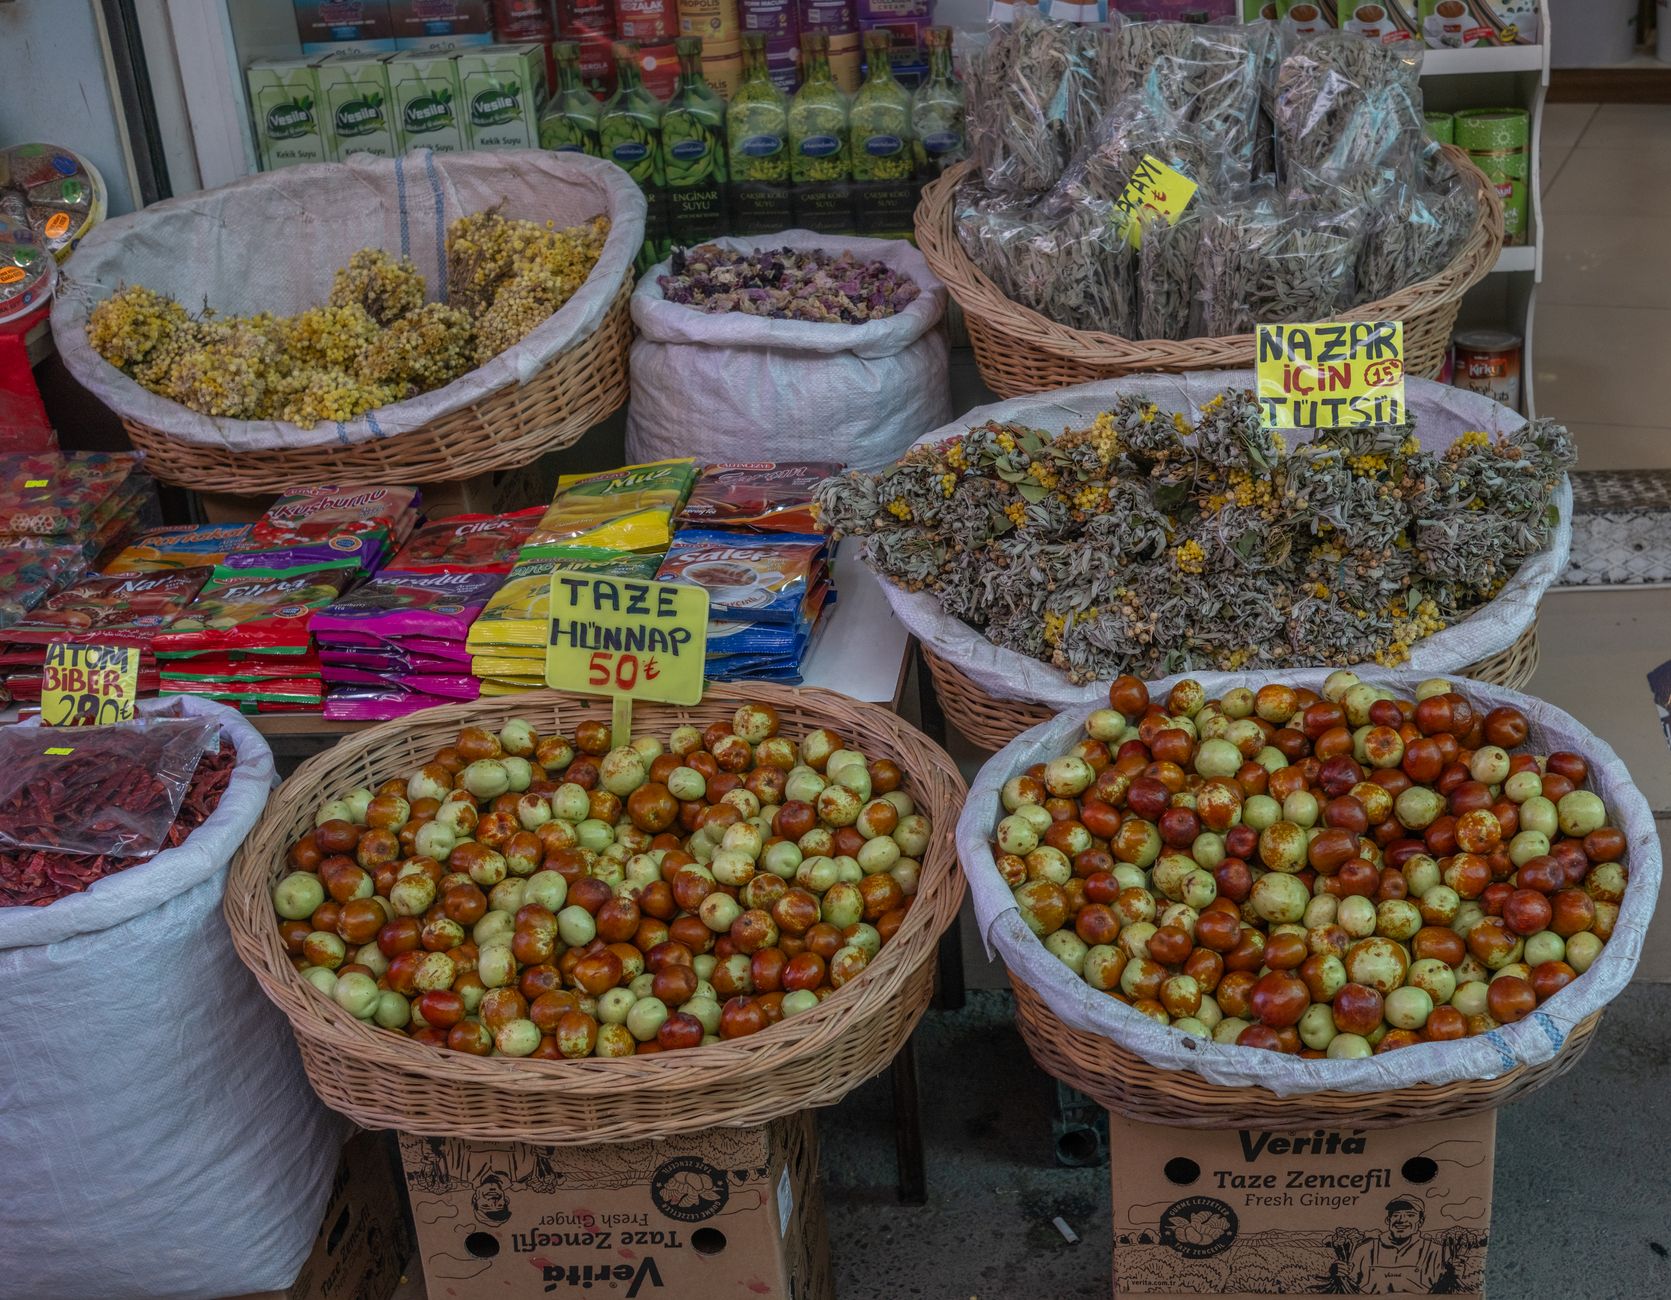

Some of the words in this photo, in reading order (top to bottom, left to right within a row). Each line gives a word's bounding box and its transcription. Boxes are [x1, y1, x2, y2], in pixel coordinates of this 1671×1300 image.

[408, 104, 446, 119] Vesile
[475, 97, 513, 112] Vesile
[270, 111, 308, 126] Vesile
[340, 108, 378, 123] Vesile
[480, 137, 500, 145] Kekik
[503, 136, 521, 145] Suyu
[276, 150, 295, 158] Kekik
[299, 150, 317, 159] Suyu
[673, 191, 718, 202] ENGİNAR
[683, 201, 710, 211] SUYU
[1259, 321, 1399, 363] NAZAR
[1259, 395, 1398, 428] TÜTSÜ
[113, 574, 175, 594] Nar
[222, 578, 307, 599] Elma
[560, 578, 678, 618] TAZE
[550, 618, 692, 657] HÜNNAP
[45, 643, 129, 674] ATOM
[42, 667, 125, 698] BİBER
[1213, 1170, 1278, 1189] Taze
[1285, 1168, 1392, 1194] Zencefil
[1244, 1192, 1294, 1207] Fresh
[1299, 1192, 1361, 1210] Ginger
[538, 1211, 596, 1229] Ginger
[601, 1212, 649, 1227] Fresh
[511, 1227, 613, 1253] Zencefil
[620, 1230, 683, 1249] Taze
